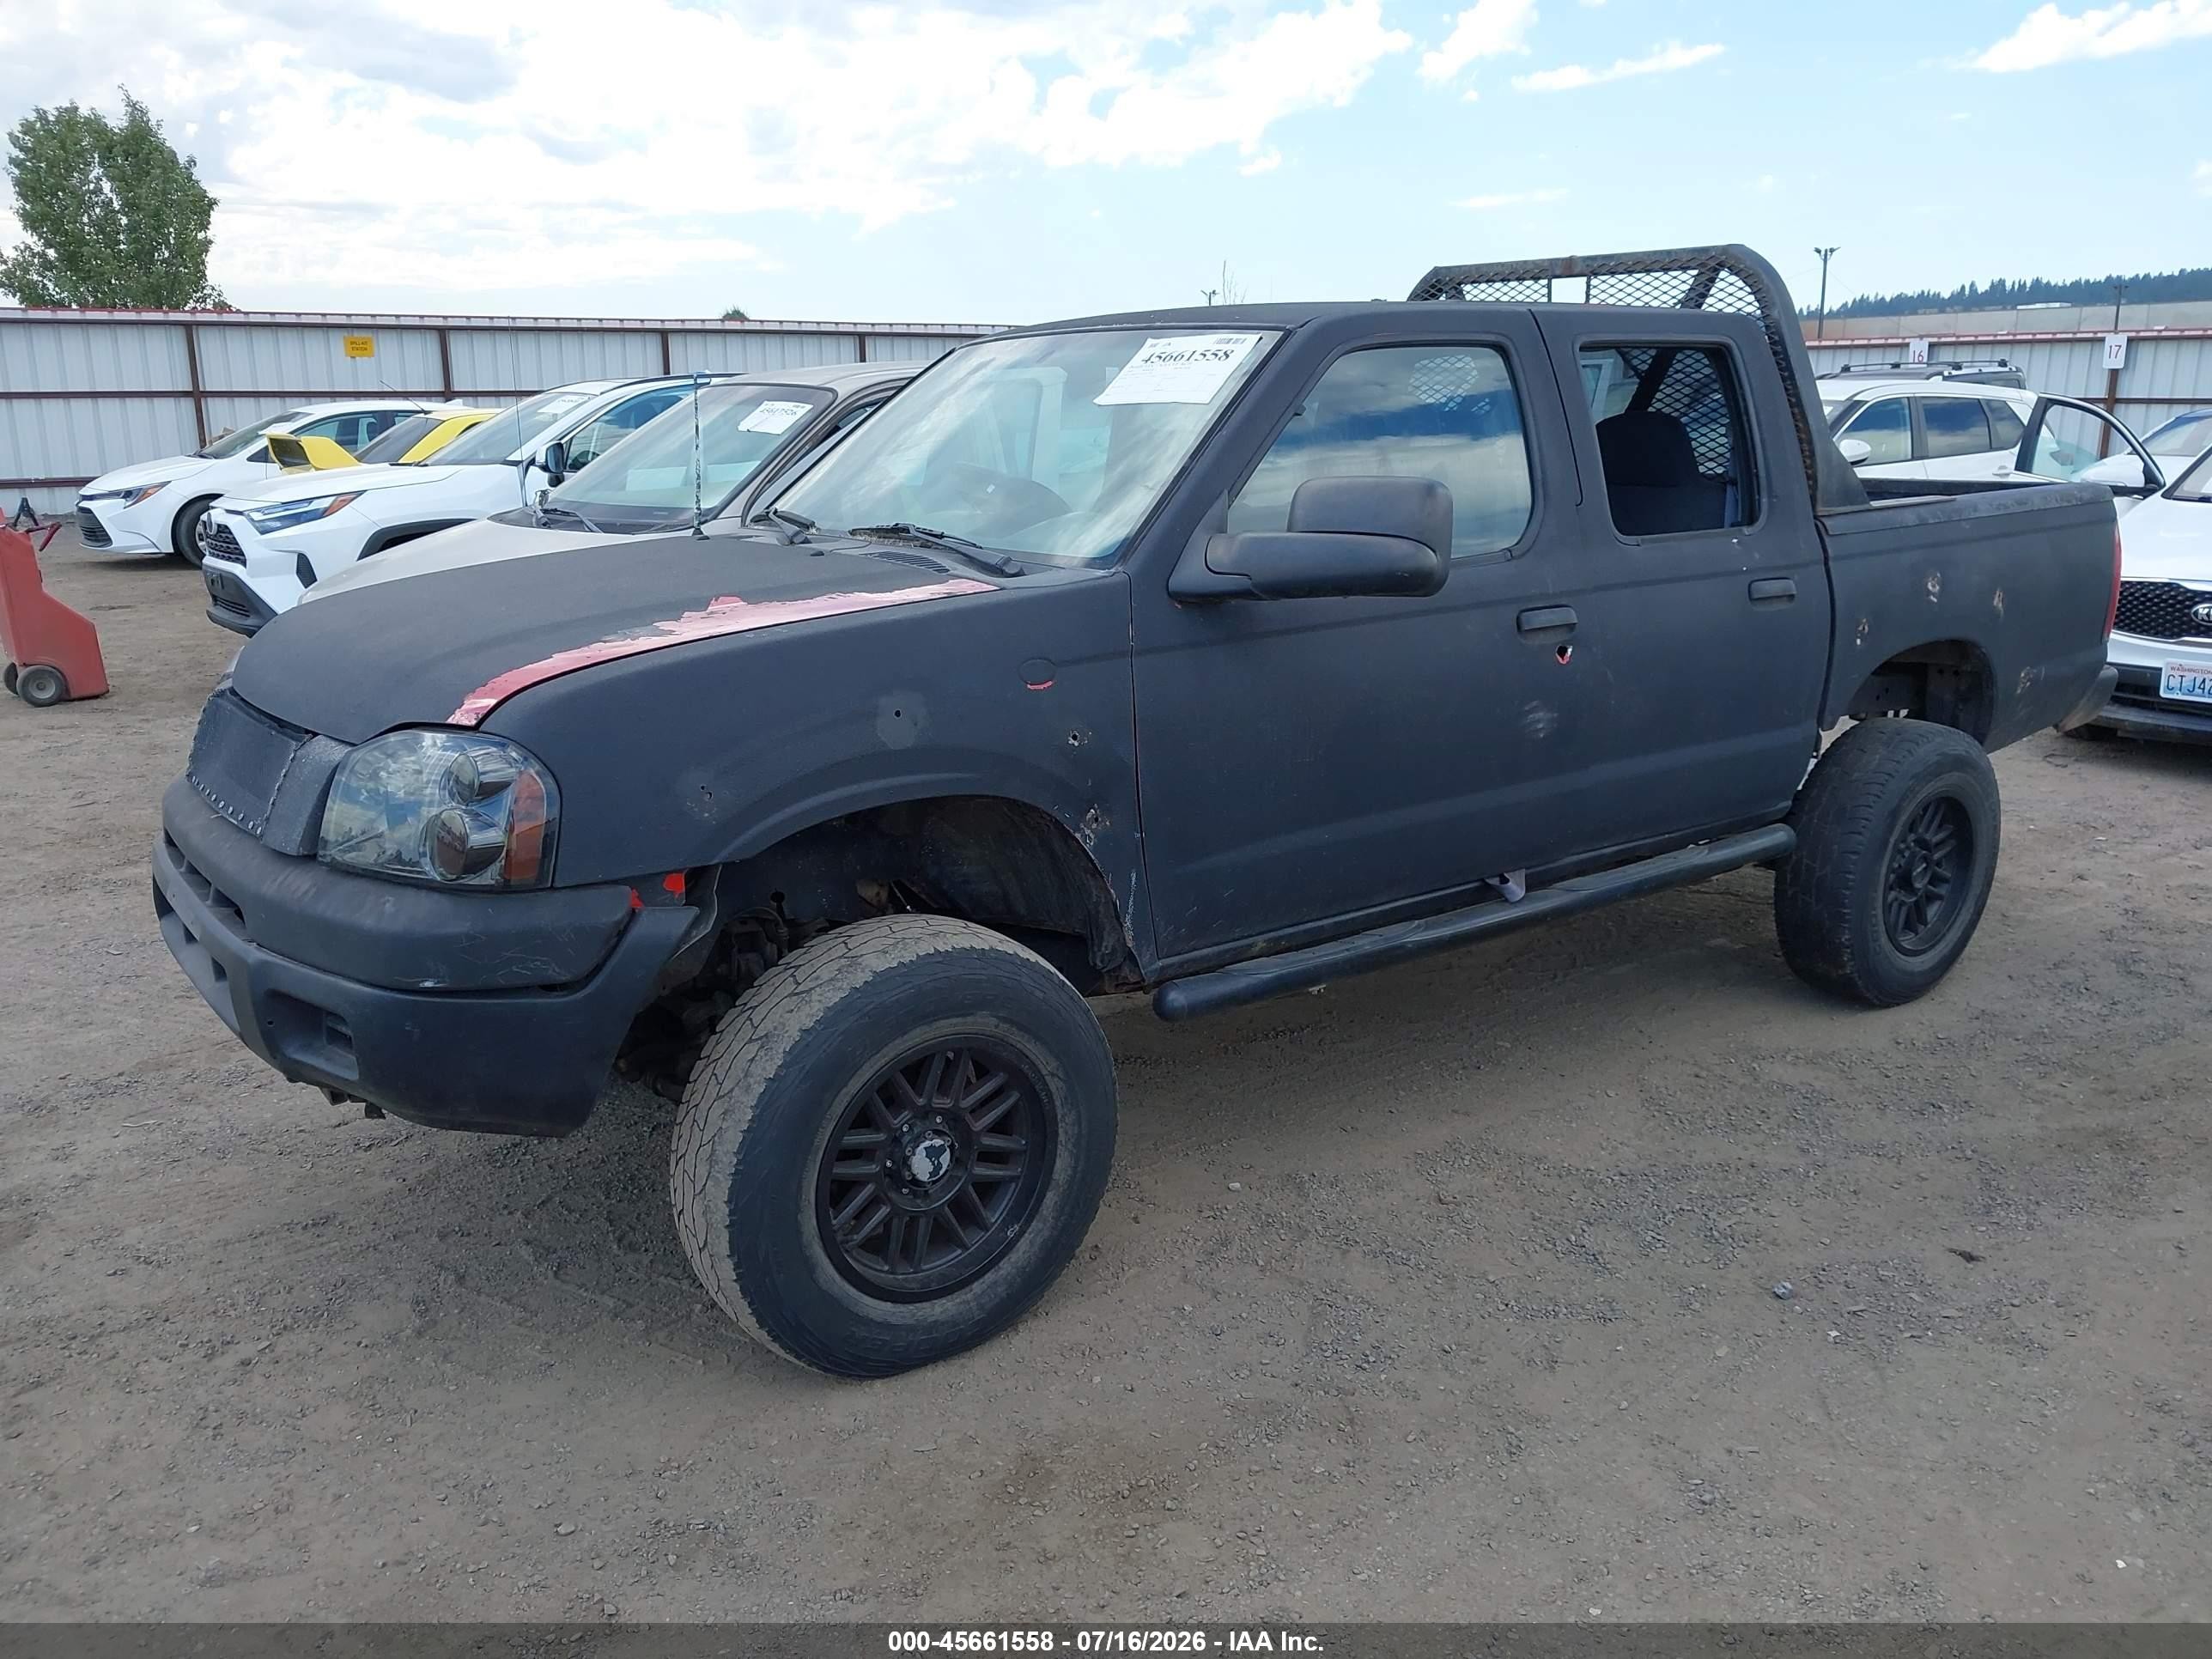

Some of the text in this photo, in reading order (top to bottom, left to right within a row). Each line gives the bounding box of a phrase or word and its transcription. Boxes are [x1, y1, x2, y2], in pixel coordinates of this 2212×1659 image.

[1140, 349, 1236, 364] 45661558
[1912, 349, 1924, 363] 16
[2108, 344, 2123, 359] 17
